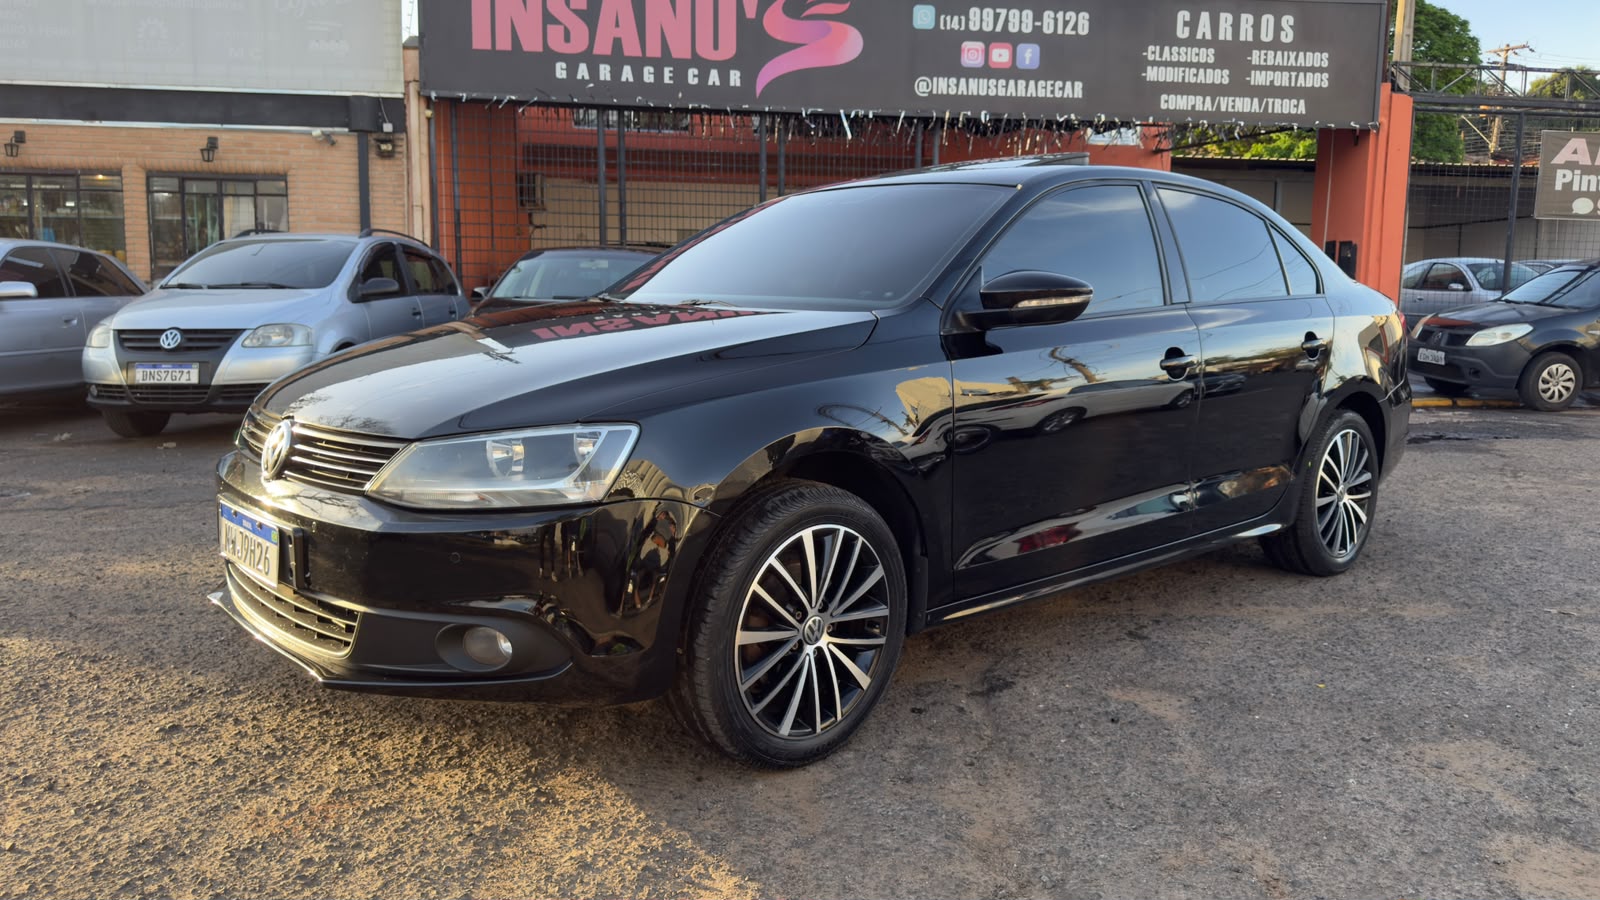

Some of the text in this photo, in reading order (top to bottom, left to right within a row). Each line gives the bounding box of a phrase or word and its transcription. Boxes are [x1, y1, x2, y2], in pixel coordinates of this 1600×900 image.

[969, 7, 1090, 35] 99799-6126
[1176, 10, 1294, 43] CARROS
[555, 62, 741, 87] GARAGE CAR
[914, 77, 1083, 99] @INSANUSGARAGECAR
[1551, 137, 1600, 166] A
